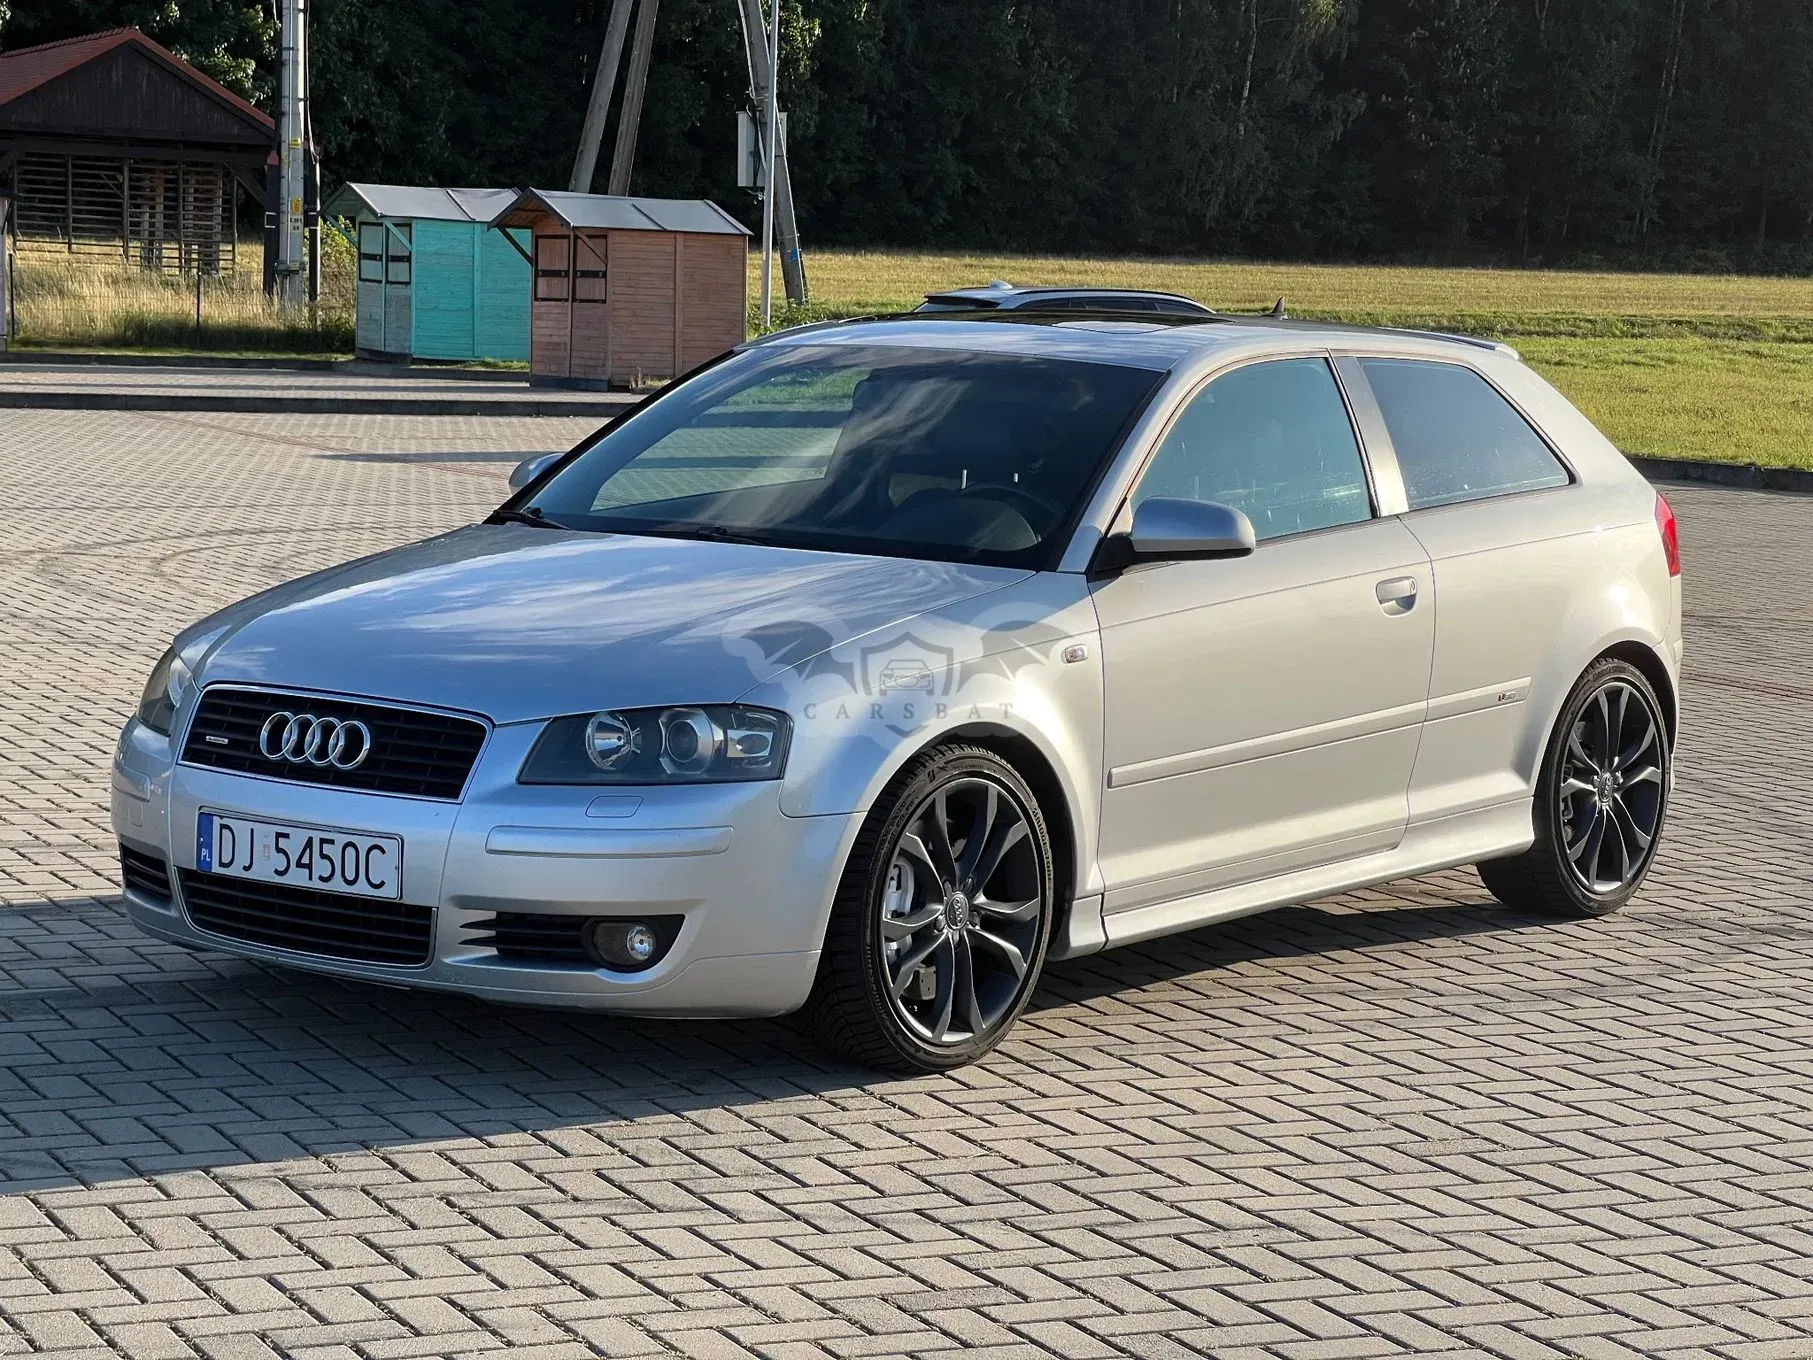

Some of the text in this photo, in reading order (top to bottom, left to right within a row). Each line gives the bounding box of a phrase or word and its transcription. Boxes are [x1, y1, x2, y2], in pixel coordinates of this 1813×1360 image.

[201, 848, 211, 862] PL
[219, 823, 387, 889] DJ 5450C
